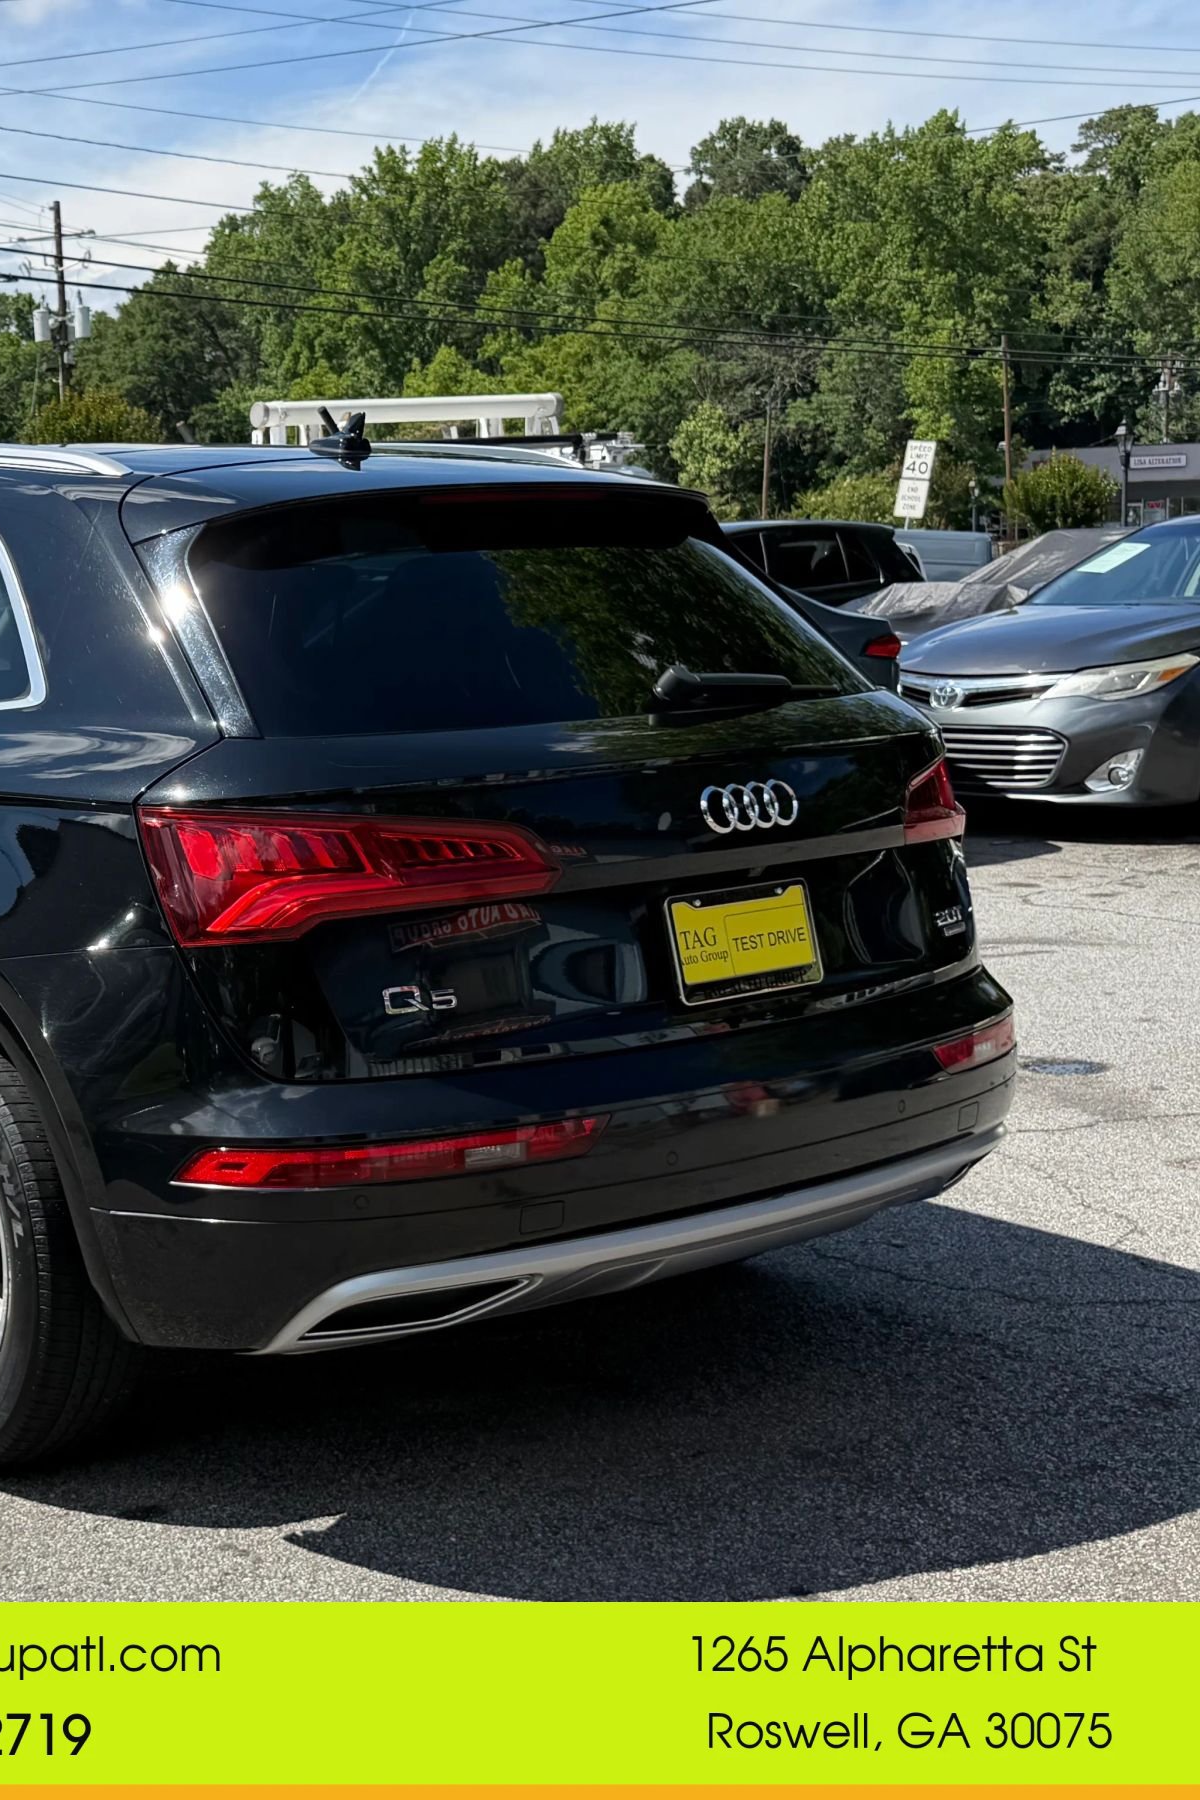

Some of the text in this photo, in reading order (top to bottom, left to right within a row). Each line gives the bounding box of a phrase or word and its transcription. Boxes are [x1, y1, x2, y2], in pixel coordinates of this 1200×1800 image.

[910, 445, 932, 453] SPEED
[905, 461, 929, 475] 40
[680, 927, 718, 951] TAG
[732, 927, 807, 952] TEST DRIVE
[701, 950, 729, 964] Group
[382, 985, 458, 1015] Q5
